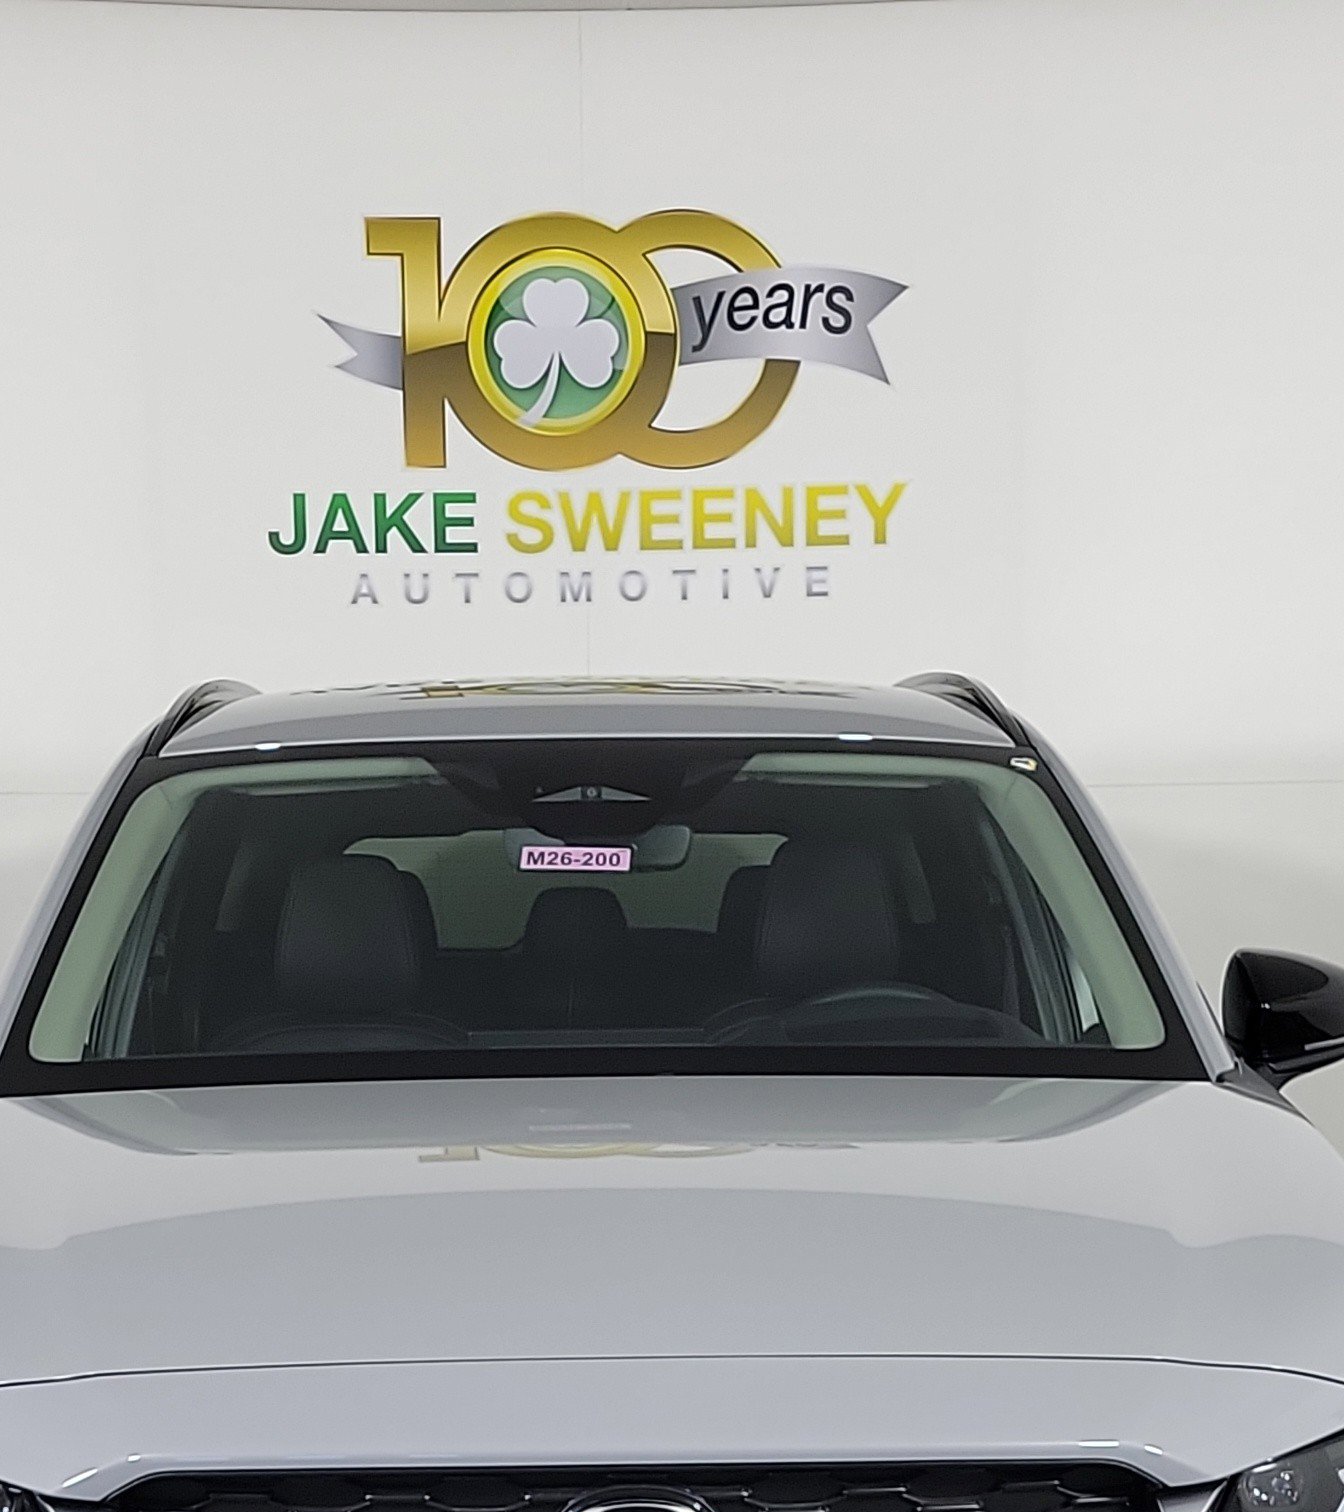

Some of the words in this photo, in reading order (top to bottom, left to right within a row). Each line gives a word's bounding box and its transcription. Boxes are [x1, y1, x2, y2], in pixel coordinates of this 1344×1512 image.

[364, 208, 800, 471] 100
[690, 280, 854, 352] years
[267, 491, 478, 555] JAKE
[505, 483, 906, 554] SWEENEY
[351, 566, 830, 605] AUTOMOTIVE
[526, 851, 621, 867] M26-200
